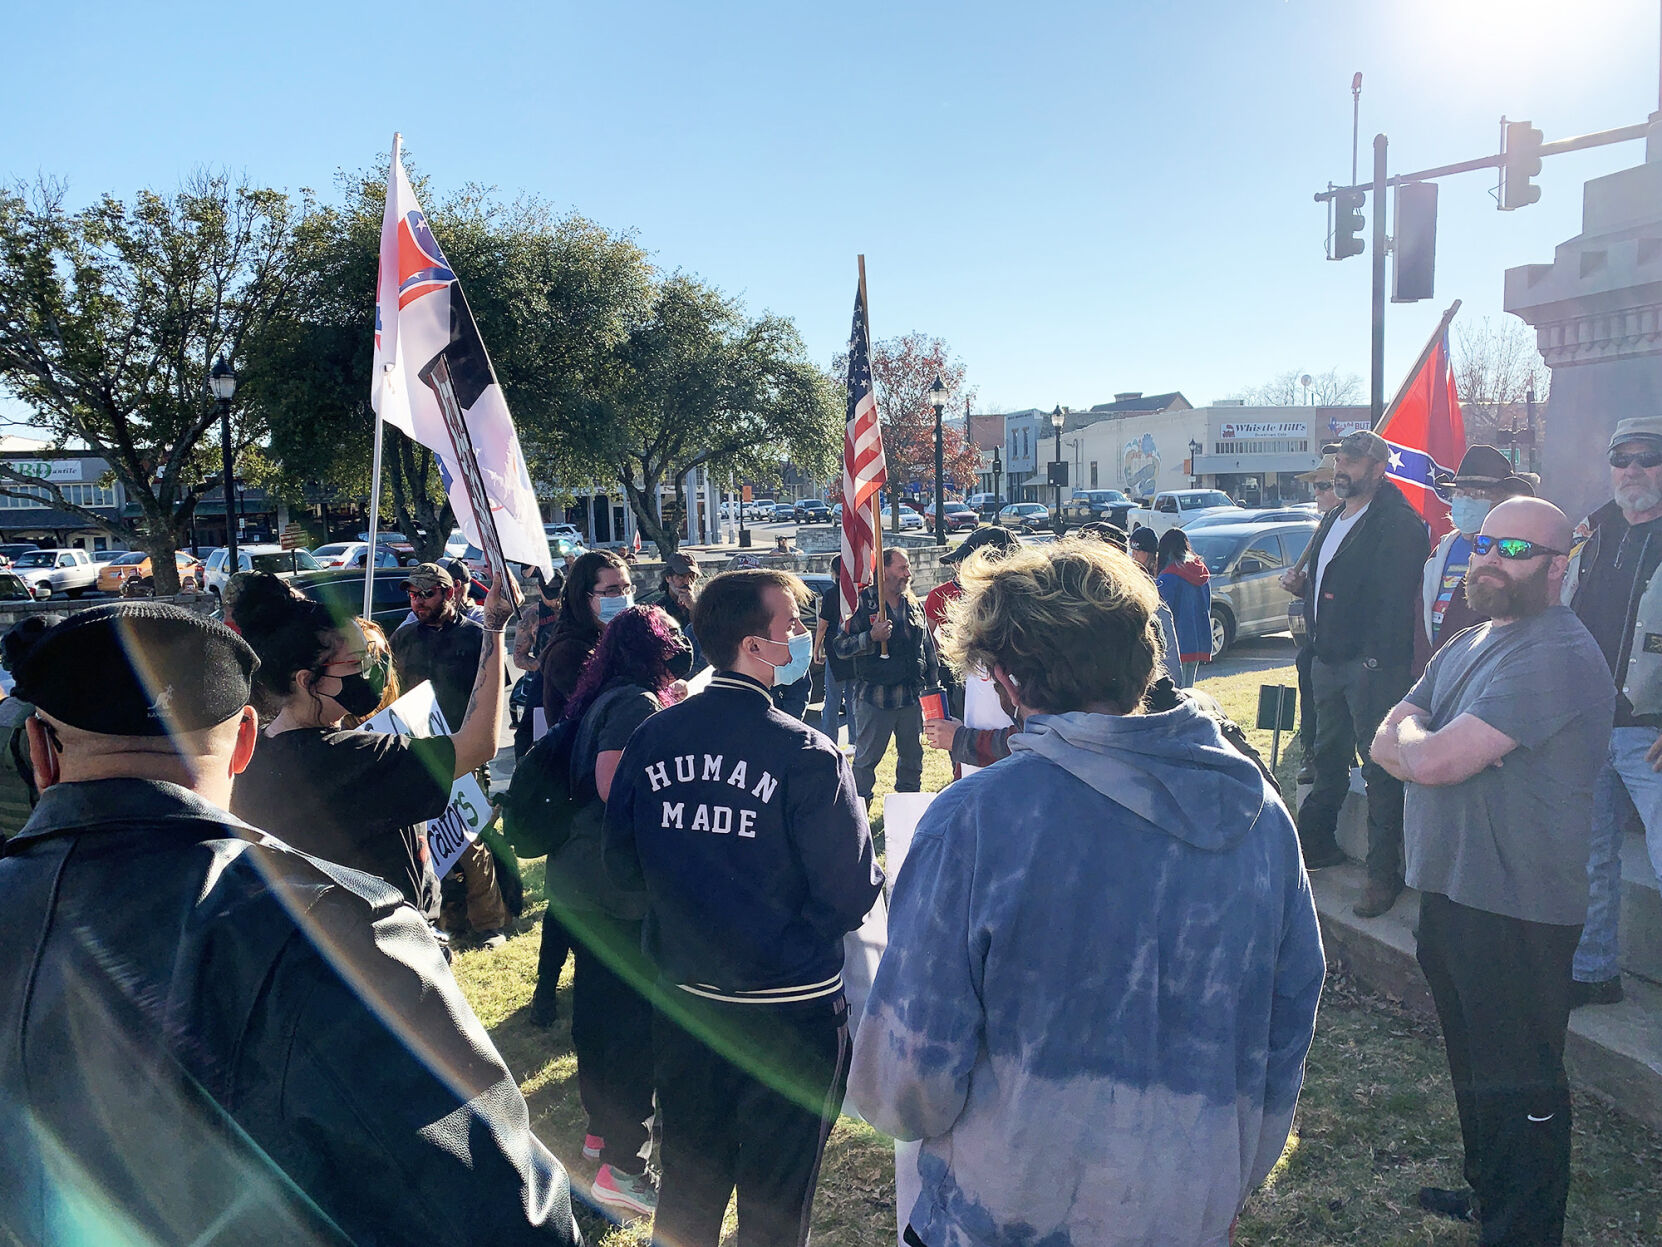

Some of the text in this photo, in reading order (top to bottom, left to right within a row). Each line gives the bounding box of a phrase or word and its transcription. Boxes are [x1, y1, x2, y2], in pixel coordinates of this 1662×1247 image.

[1236, 423, 1306, 432] Whistle Hill's
[645, 754, 778, 804] HUMAN
[661, 801, 757, 838] MADE
